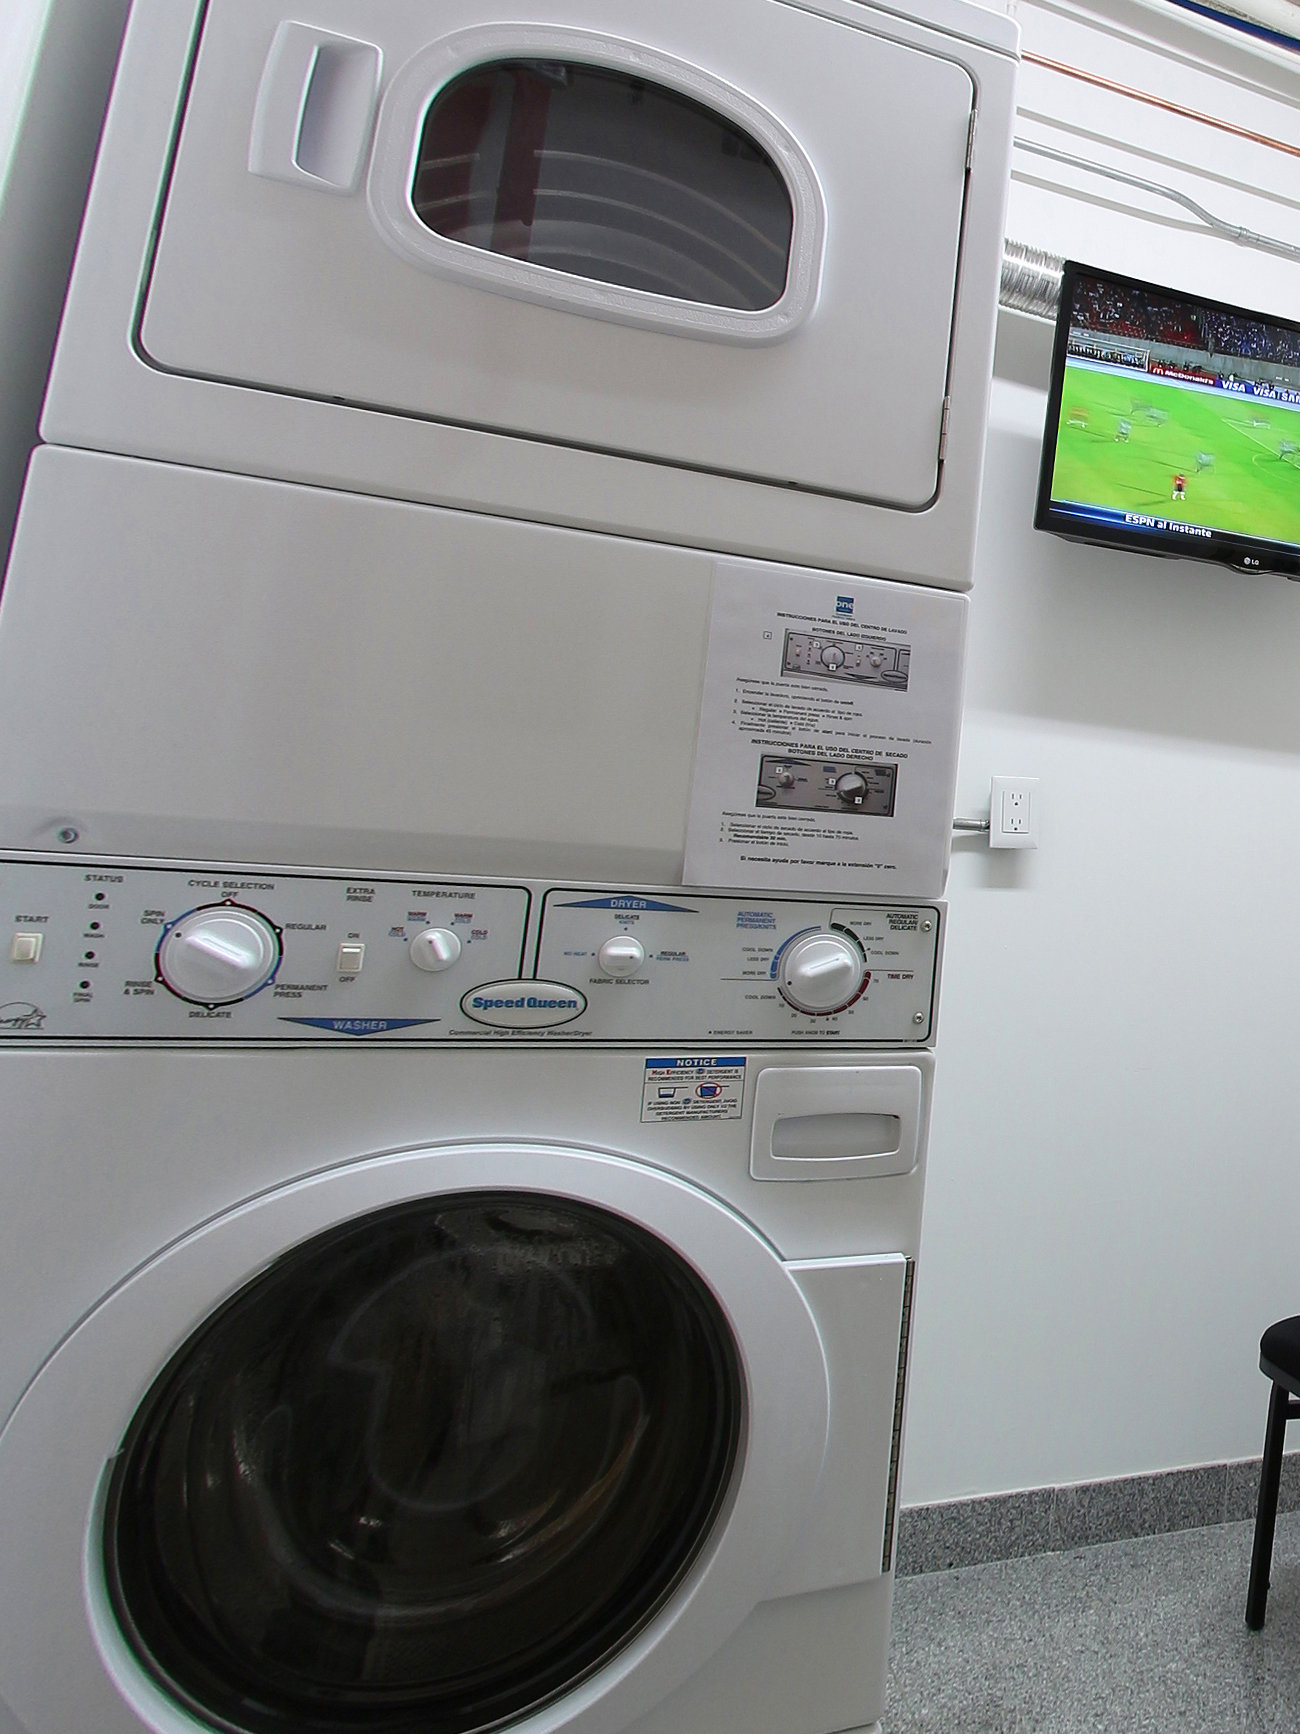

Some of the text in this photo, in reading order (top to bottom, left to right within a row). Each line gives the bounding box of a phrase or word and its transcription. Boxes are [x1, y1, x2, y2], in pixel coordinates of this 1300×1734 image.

[1164, 370, 1214, 386] McDonald's
[1221, 379, 1277, 399] VISA VISA
[1125, 513, 1212, 538] ESPN al Instante
[84, 874, 124, 883] STATUS
[188, 880, 274, 890] CYCLE SELECTION
[221, 891, 239, 899] OFF
[346, 887, 375, 895] EXTRA
[412, 890, 476, 900] TEMPERATURE
[346, 895, 373, 903] RINSE
[610, 900, 647, 909] DRYER
[15, 915, 49, 924] START
[141, 917, 164, 925] ONLY
[285, 922, 327, 931] REGULAR
[274, 983, 328, 992] PERMANENT
[472, 997, 578, 1011] Speed Queen
[189, 1011, 232, 1019] DELICATE
[333, 1020, 387, 1030] WASHER
[676, 1059, 718, 1067] NOTICE
